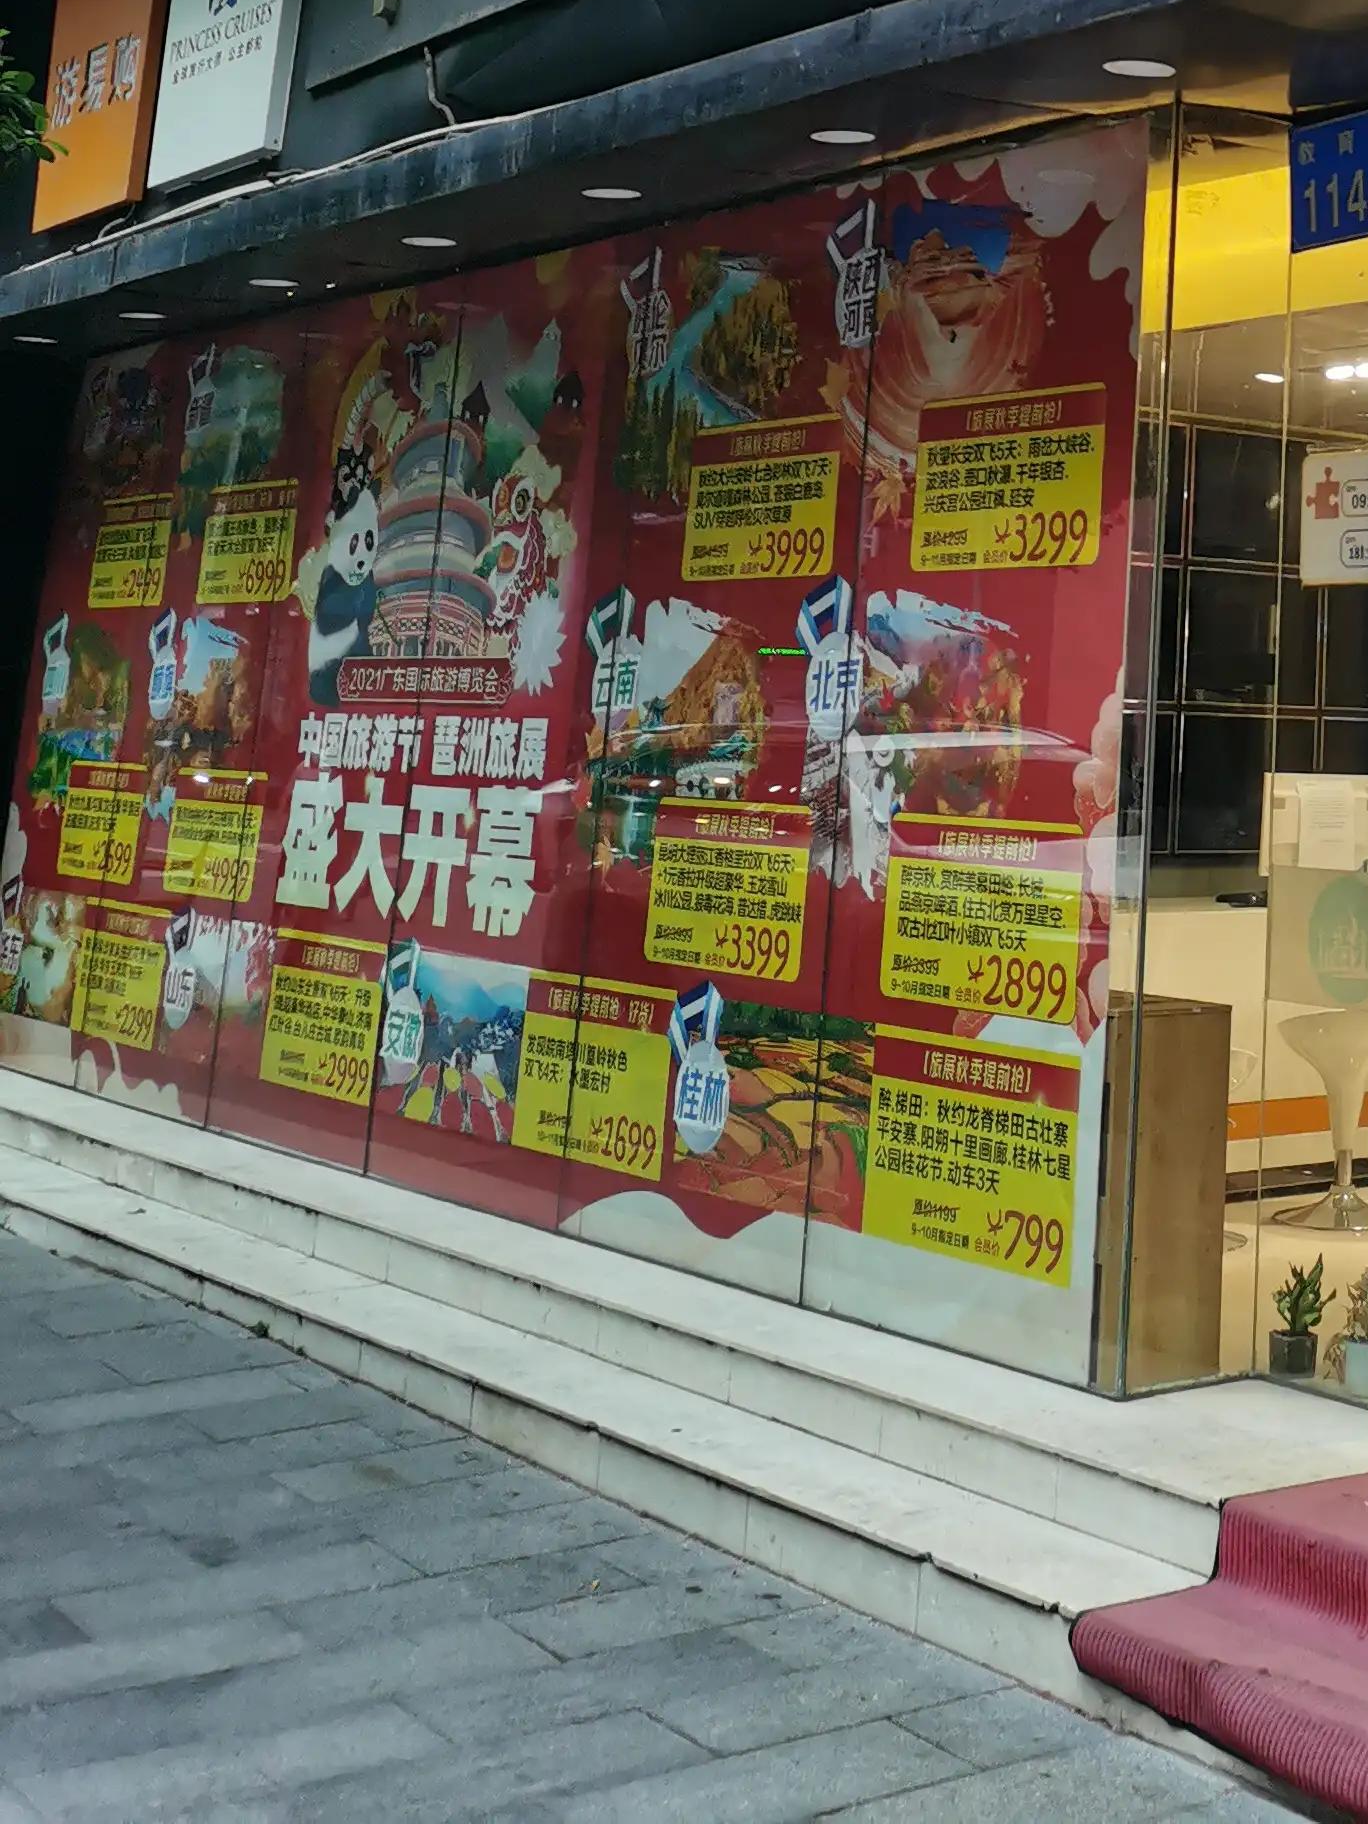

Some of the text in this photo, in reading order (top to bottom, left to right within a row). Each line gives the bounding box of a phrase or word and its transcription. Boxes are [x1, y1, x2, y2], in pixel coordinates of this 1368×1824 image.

[1304, 169, 1368, 233] 114
[349, 665, 499, 694] 2021广东国际旅游博览会
[809, 657, 860, 715] 北京
[298, 711, 549, 781] 中国旅游节 琶洲旅展
[275, 771, 544, 938] 盛大开幕
[715, 924, 790, 979] ¥3399
[967, 955, 1067, 1019] ¥2899
[678, 1065, 727, 1126] 桂林
[591, 1115, 657, 1170] ¥1699
[986, 1208, 1065, 1274] ¥799
